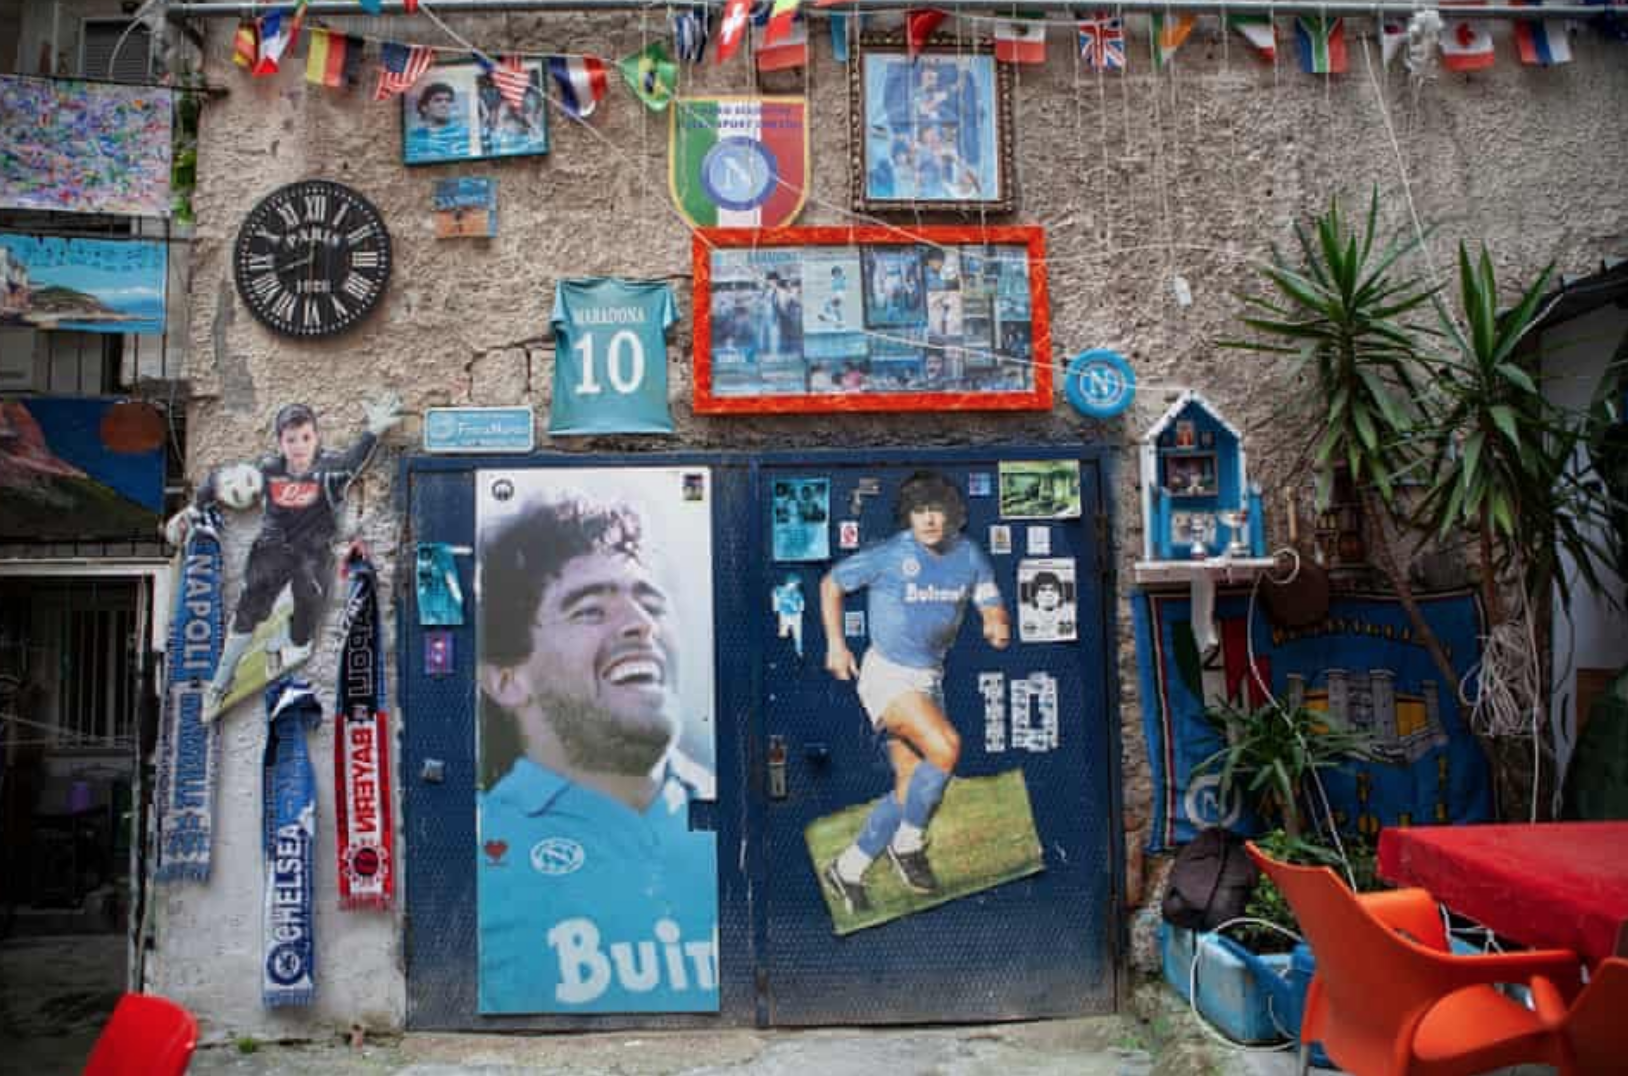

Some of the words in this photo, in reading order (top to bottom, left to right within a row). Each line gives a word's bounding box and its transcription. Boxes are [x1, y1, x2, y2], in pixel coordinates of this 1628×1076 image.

[573, 330, 645, 394] 10
[183, 554, 212, 669] NAPOLI
[274, 824, 302, 943] CHELSEA
